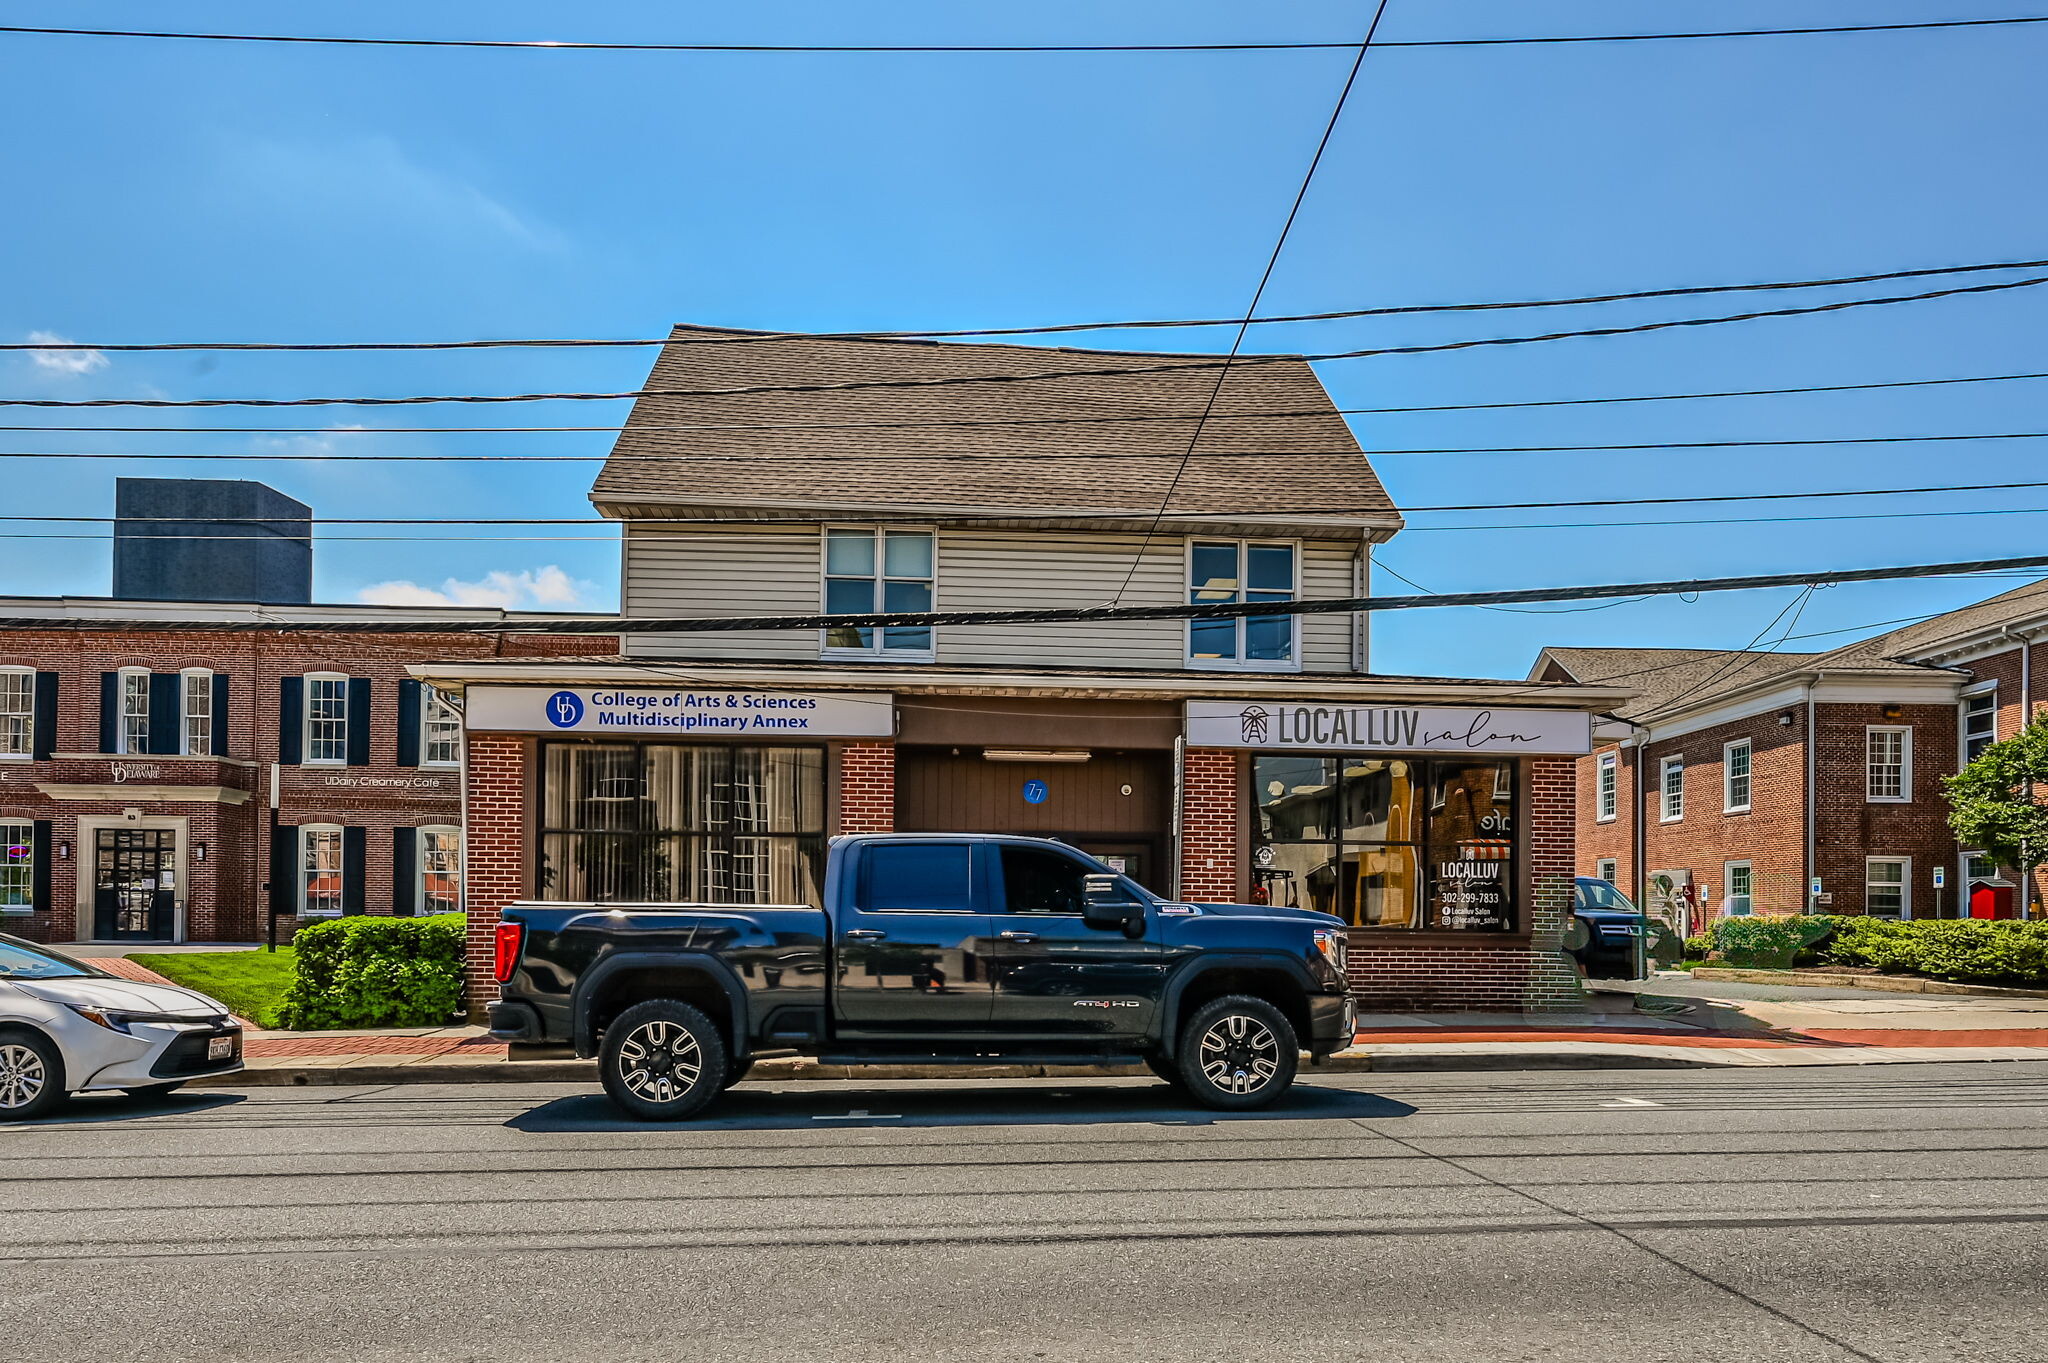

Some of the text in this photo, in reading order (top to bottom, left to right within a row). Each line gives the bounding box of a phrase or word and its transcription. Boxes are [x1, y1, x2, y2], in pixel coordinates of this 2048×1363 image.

[591, 692, 817, 710] College of Arts & Sciences
[598, 711, 808, 731] Multidisciplinary Annex
[1279, 707, 1542, 748] LOCALLUV salon
[325, 776, 358, 787] UDairy
[360, 776, 411, 788] Creamery
[1029, 783, 1043, 801] 77
[1442, 862, 1499, 878] LOCALLUV
[1442, 892, 1499, 904] 302-299-7833
